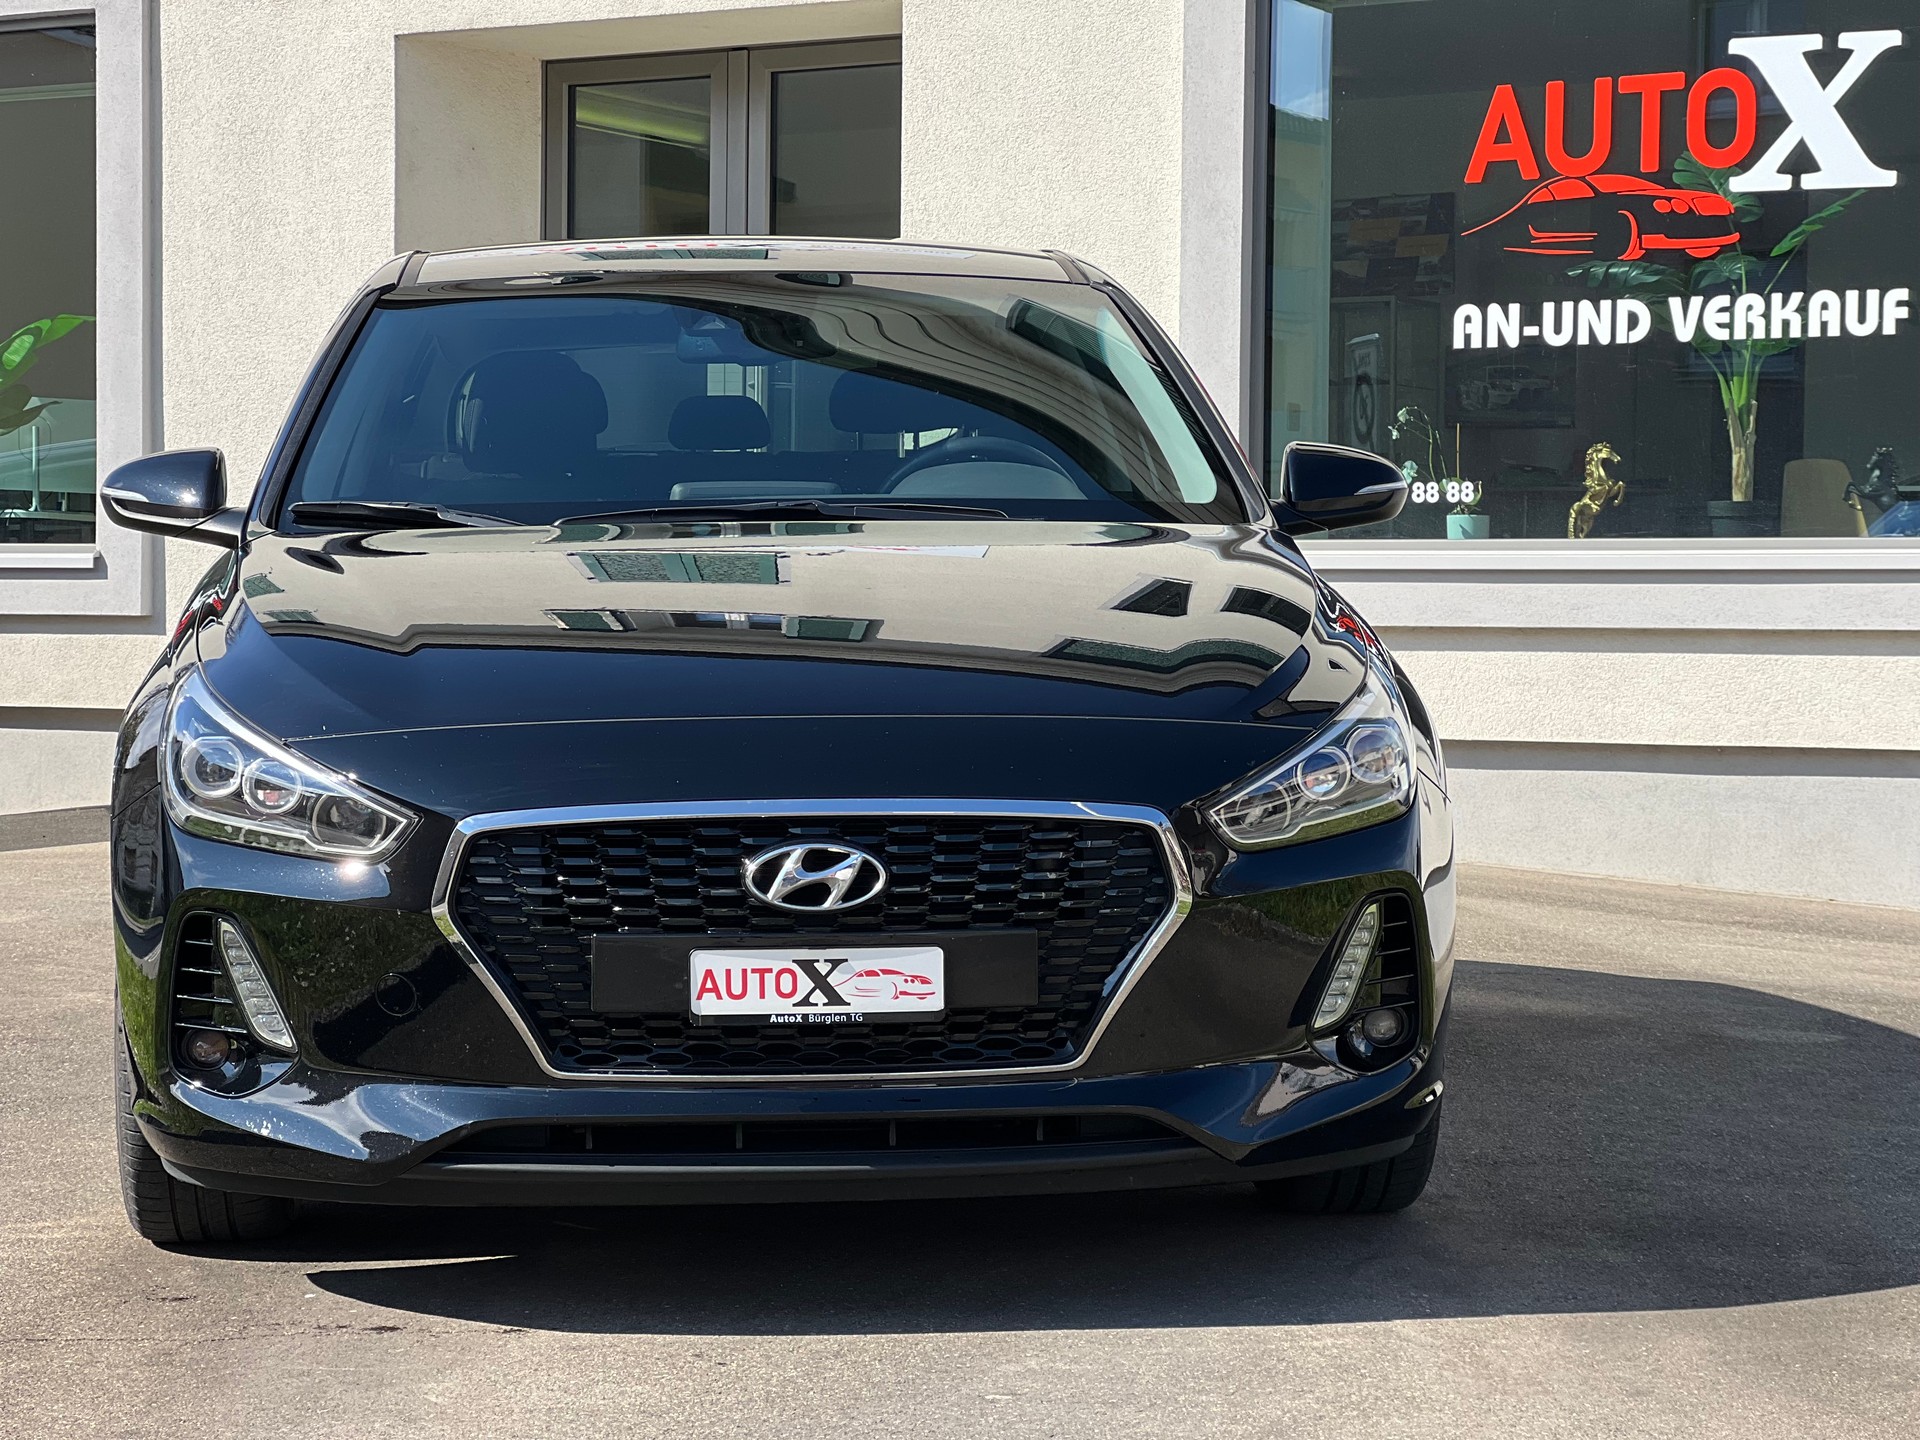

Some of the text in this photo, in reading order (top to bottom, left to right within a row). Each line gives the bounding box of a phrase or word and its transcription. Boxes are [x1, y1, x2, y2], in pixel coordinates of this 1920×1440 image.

[1453, 288, 1909, 350] AN-UND VERKAUF
[1411, 481, 1475, 503] 88 88
[696, 958, 851, 1007] AUTOX
[770, 1012, 863, 1025] AutoX Bürglen TG
